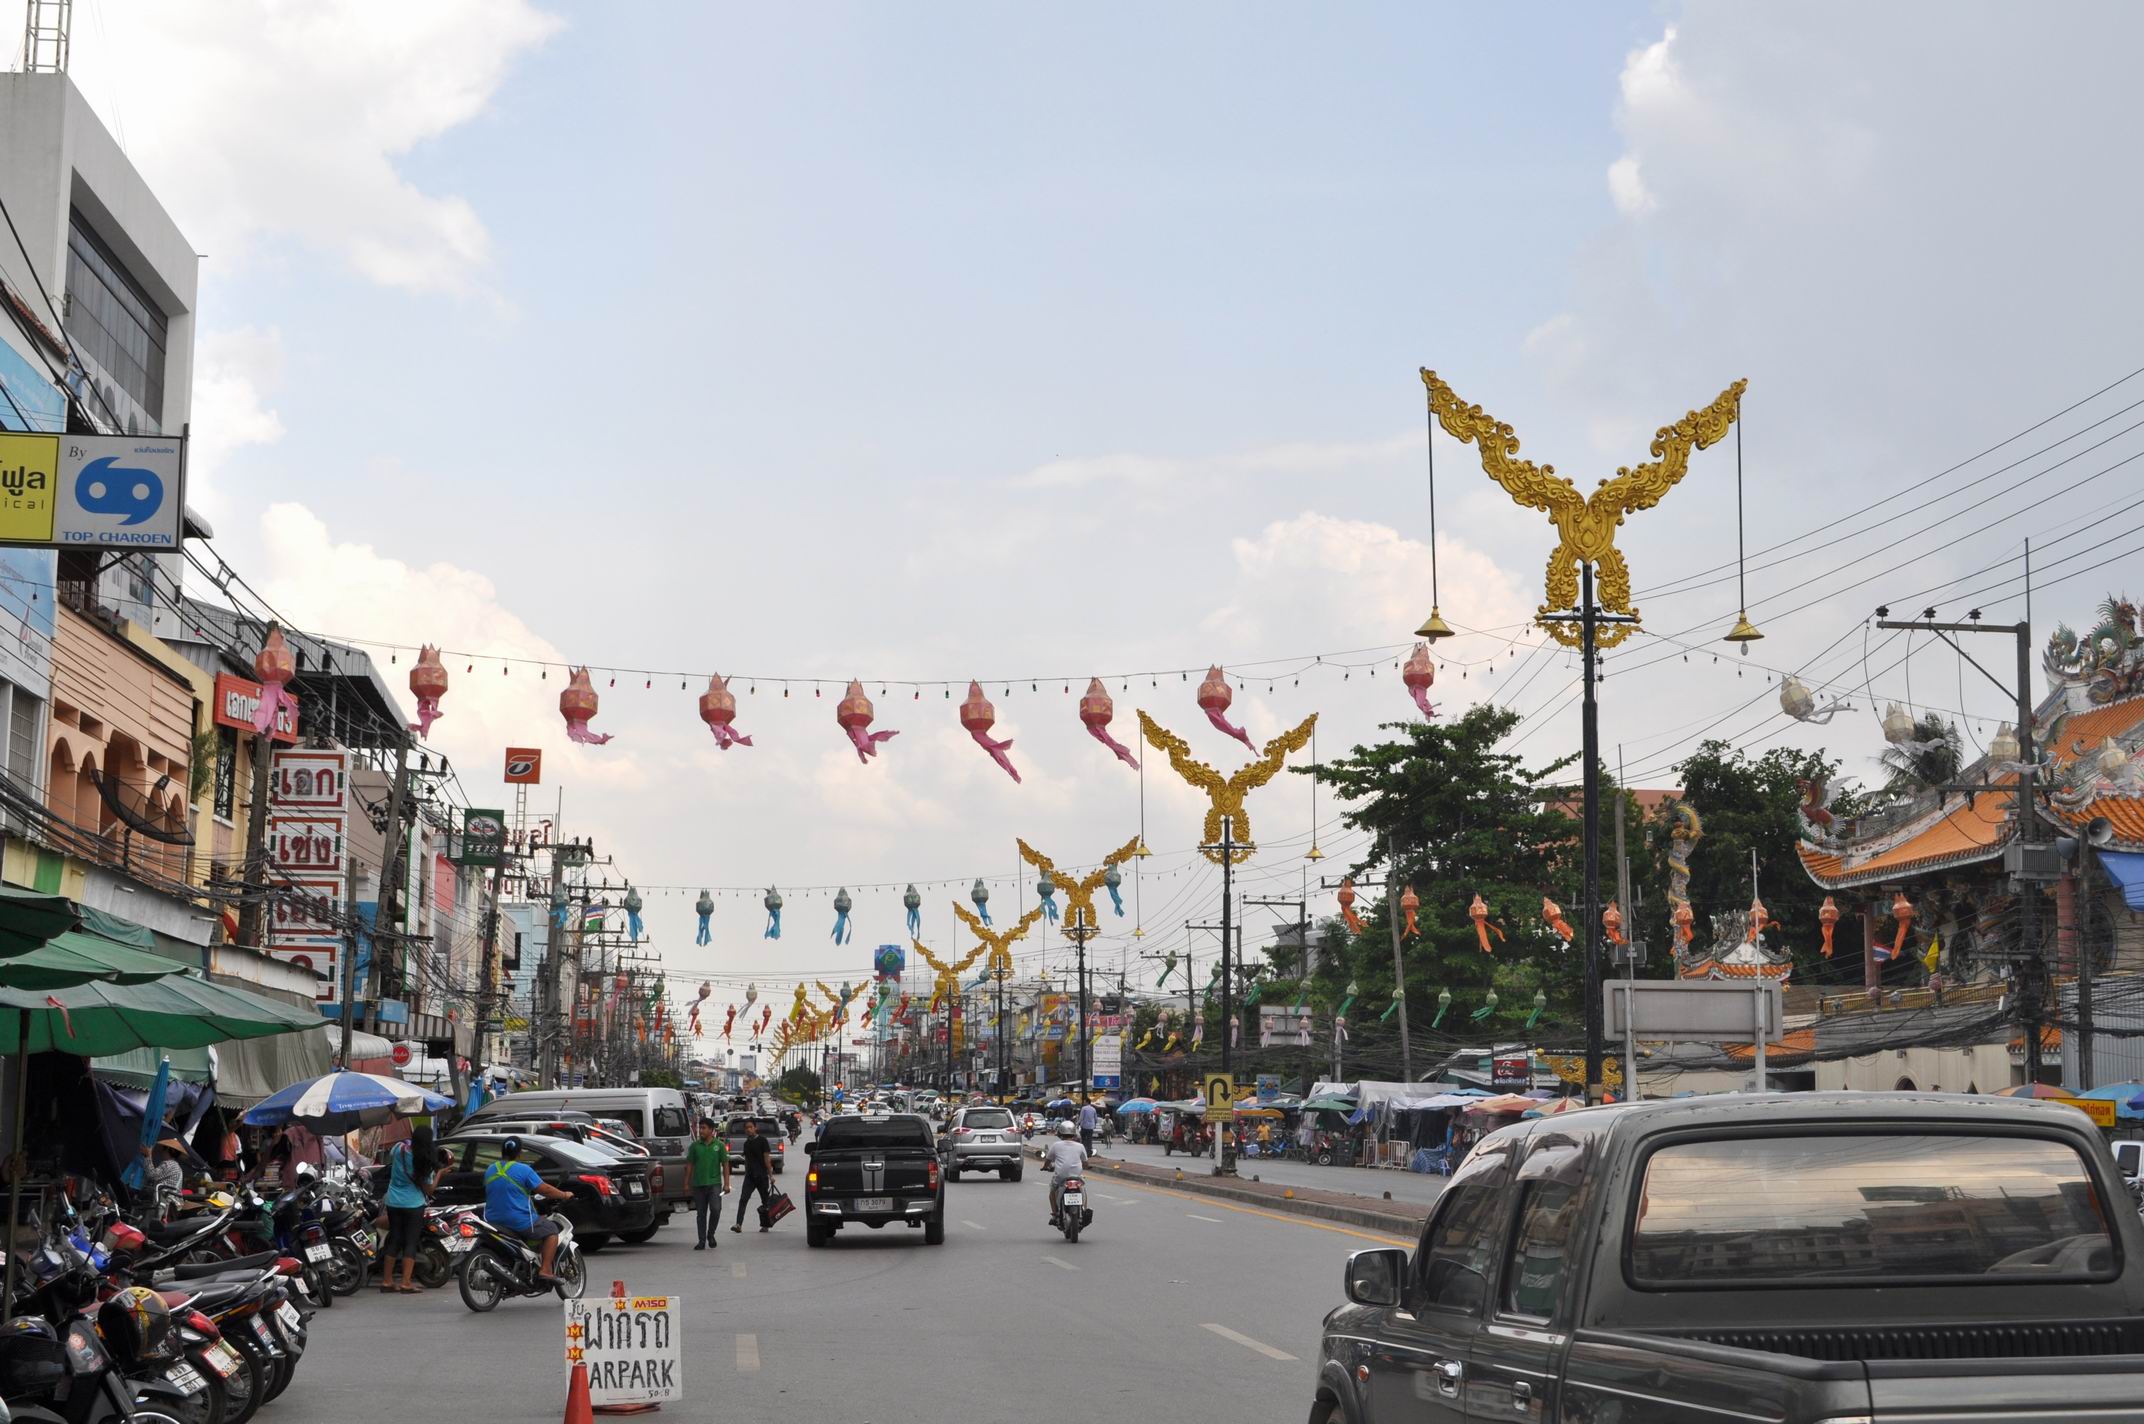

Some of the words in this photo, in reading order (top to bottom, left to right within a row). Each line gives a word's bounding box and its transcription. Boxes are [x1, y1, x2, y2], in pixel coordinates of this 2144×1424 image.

[69, 446, 87, 461] By
[63, 531, 94, 542] TOP
[99, 532, 172, 544] CHAROEN
[281, 767, 335, 796] เอก
[634, 1299, 667, 1308] M-150
[578, 1359, 676, 1389] ARPARK
